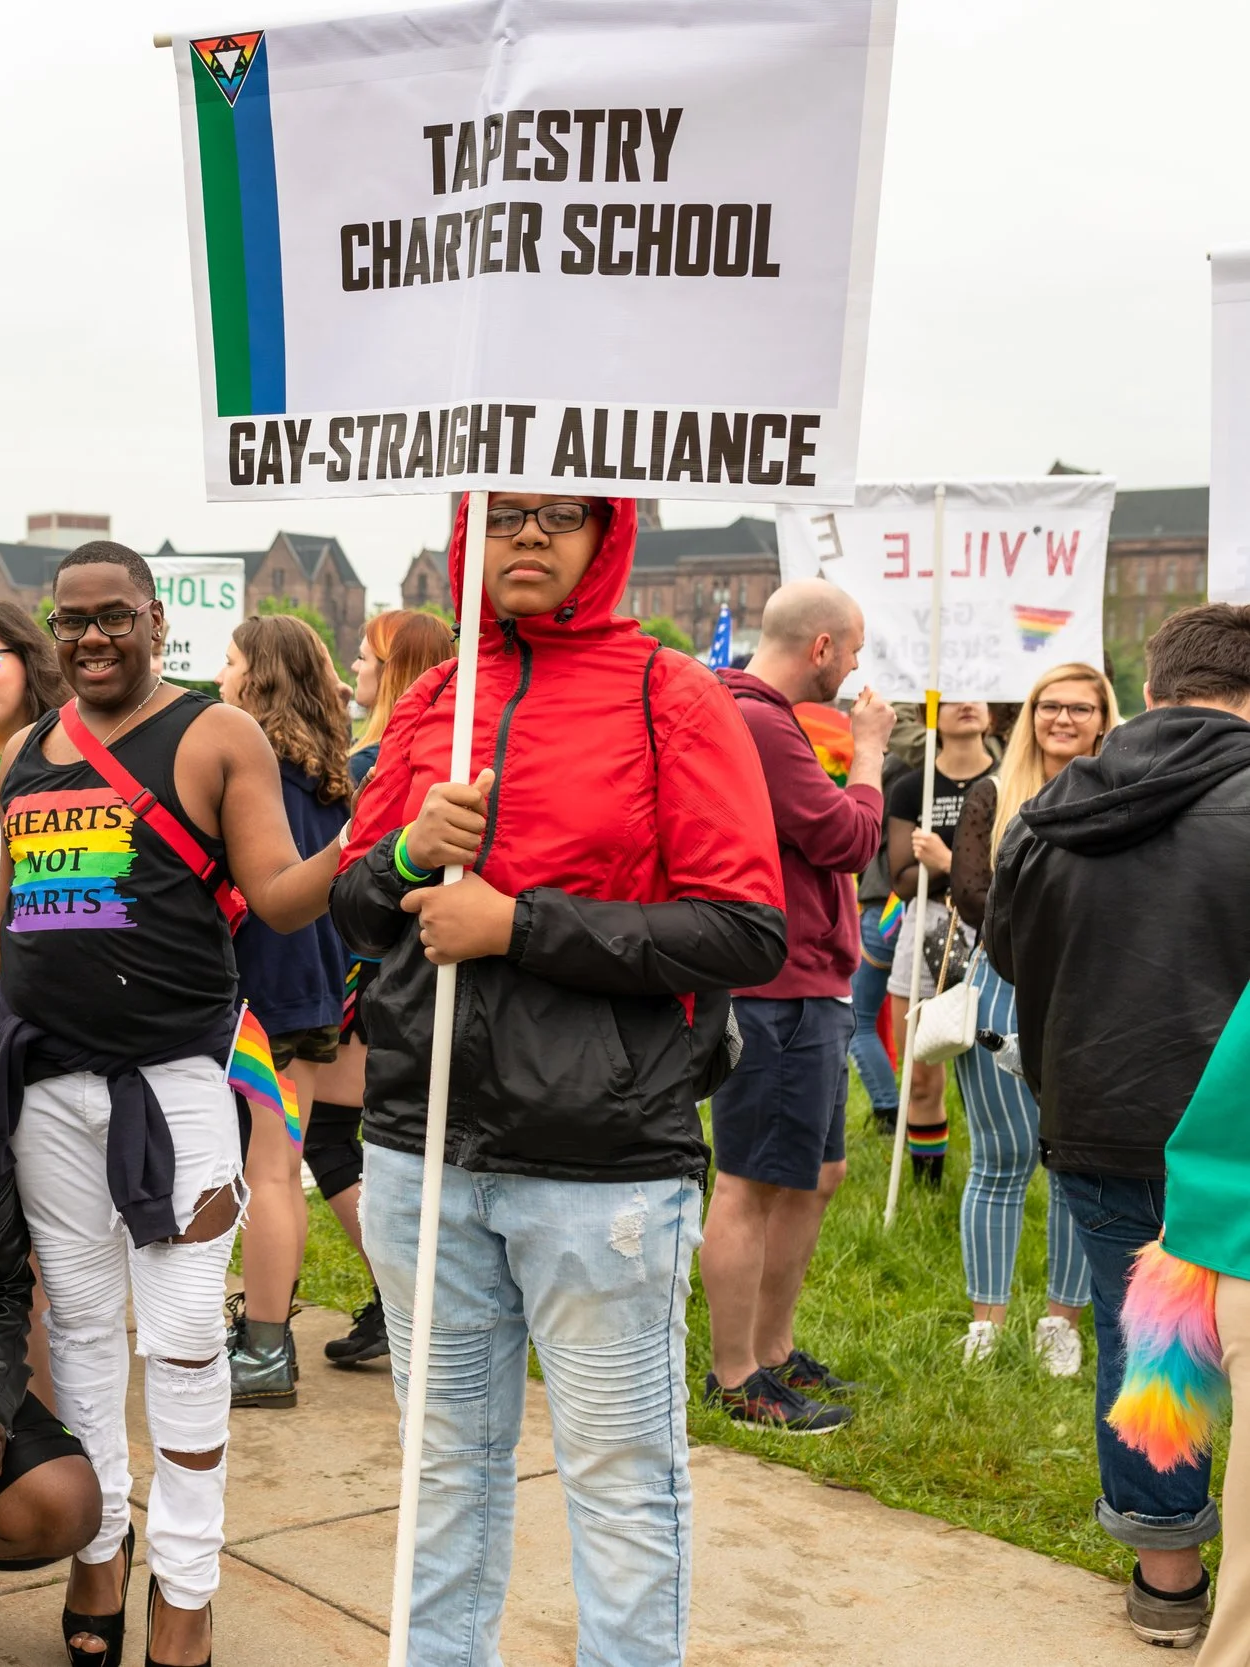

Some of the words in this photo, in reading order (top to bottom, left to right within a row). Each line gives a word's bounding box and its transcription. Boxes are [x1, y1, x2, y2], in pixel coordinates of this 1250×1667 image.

[423, 107, 683, 195] TAPESTRY
[341, 202, 542, 291] CHARTER
[561, 203, 781, 278] SCHOOL
[229, 404, 536, 486] GAY-STRAIGHT
[551, 408, 820, 486] ALLIANCE
[156, 576, 235, 609] HOLS
[6, 804, 122, 838] HEARTS
[26, 847, 88, 874] NOT
[14, 888, 101, 917] PARTS
